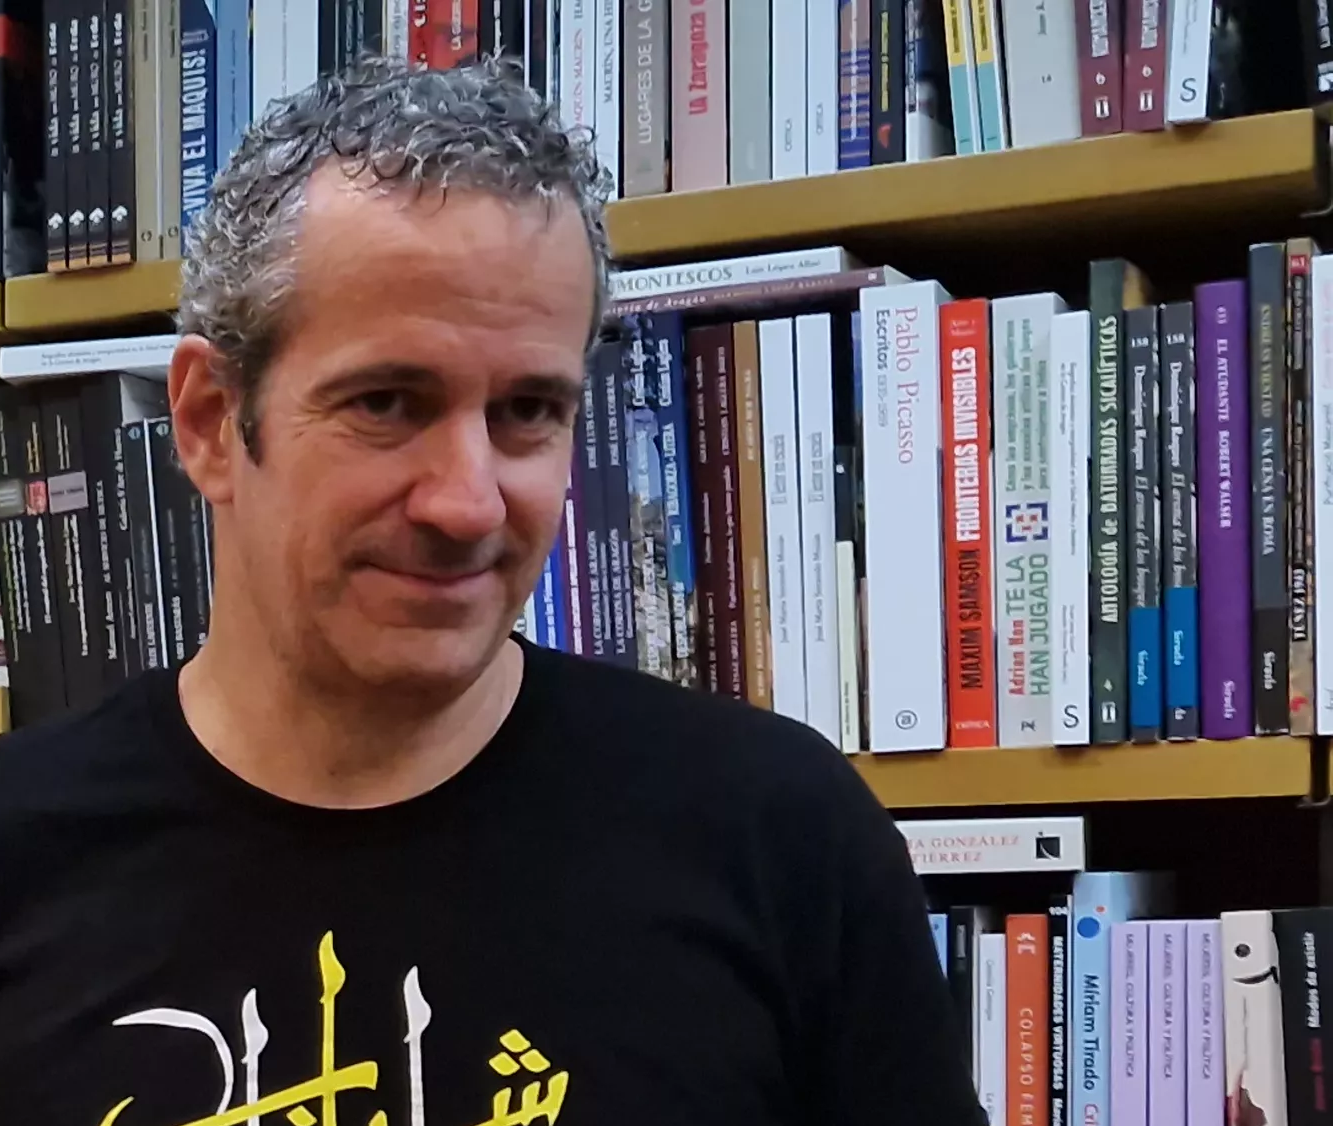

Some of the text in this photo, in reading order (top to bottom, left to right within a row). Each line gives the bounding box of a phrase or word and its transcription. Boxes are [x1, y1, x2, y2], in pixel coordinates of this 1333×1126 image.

[181, 48, 208, 161] EL MAQUIS!
[637, 18, 653, 144] LUGARES DE LA
[876, 309, 891, 371] Escritos
[1217, 338, 1229, 354] EL
[895, 306, 921, 465] Pablo Picasso
[1217, 357, 1230, 422] AYUDANTE
[1097, 315, 1119, 624] ANTOLOGÍA de BATURRADAS SICALÍPTICAS
[951, 347, 982, 690] MAXIM SAMSON FRONTERAS INVISIBLES
[1262, 516, 1274, 555] ROMA
[1004, 556, 1025, 696] Adrian Hon TE LA
[1028, 553, 1050, 696] HAN JUGADO
[930, 833, 1020, 849] GONZÁLEZ
[1052, 935, 1064, 1023] MATERNIDADES
[1303, 931, 1318, 969] existir
[1306, 988, 1321, 1028] Modos
[1019, 1007, 1034, 1086] COLAPSO
[1052, 1025, 1064, 1090] VIRTUOSAS
[1083, 1036, 1100, 1091] Tirado
